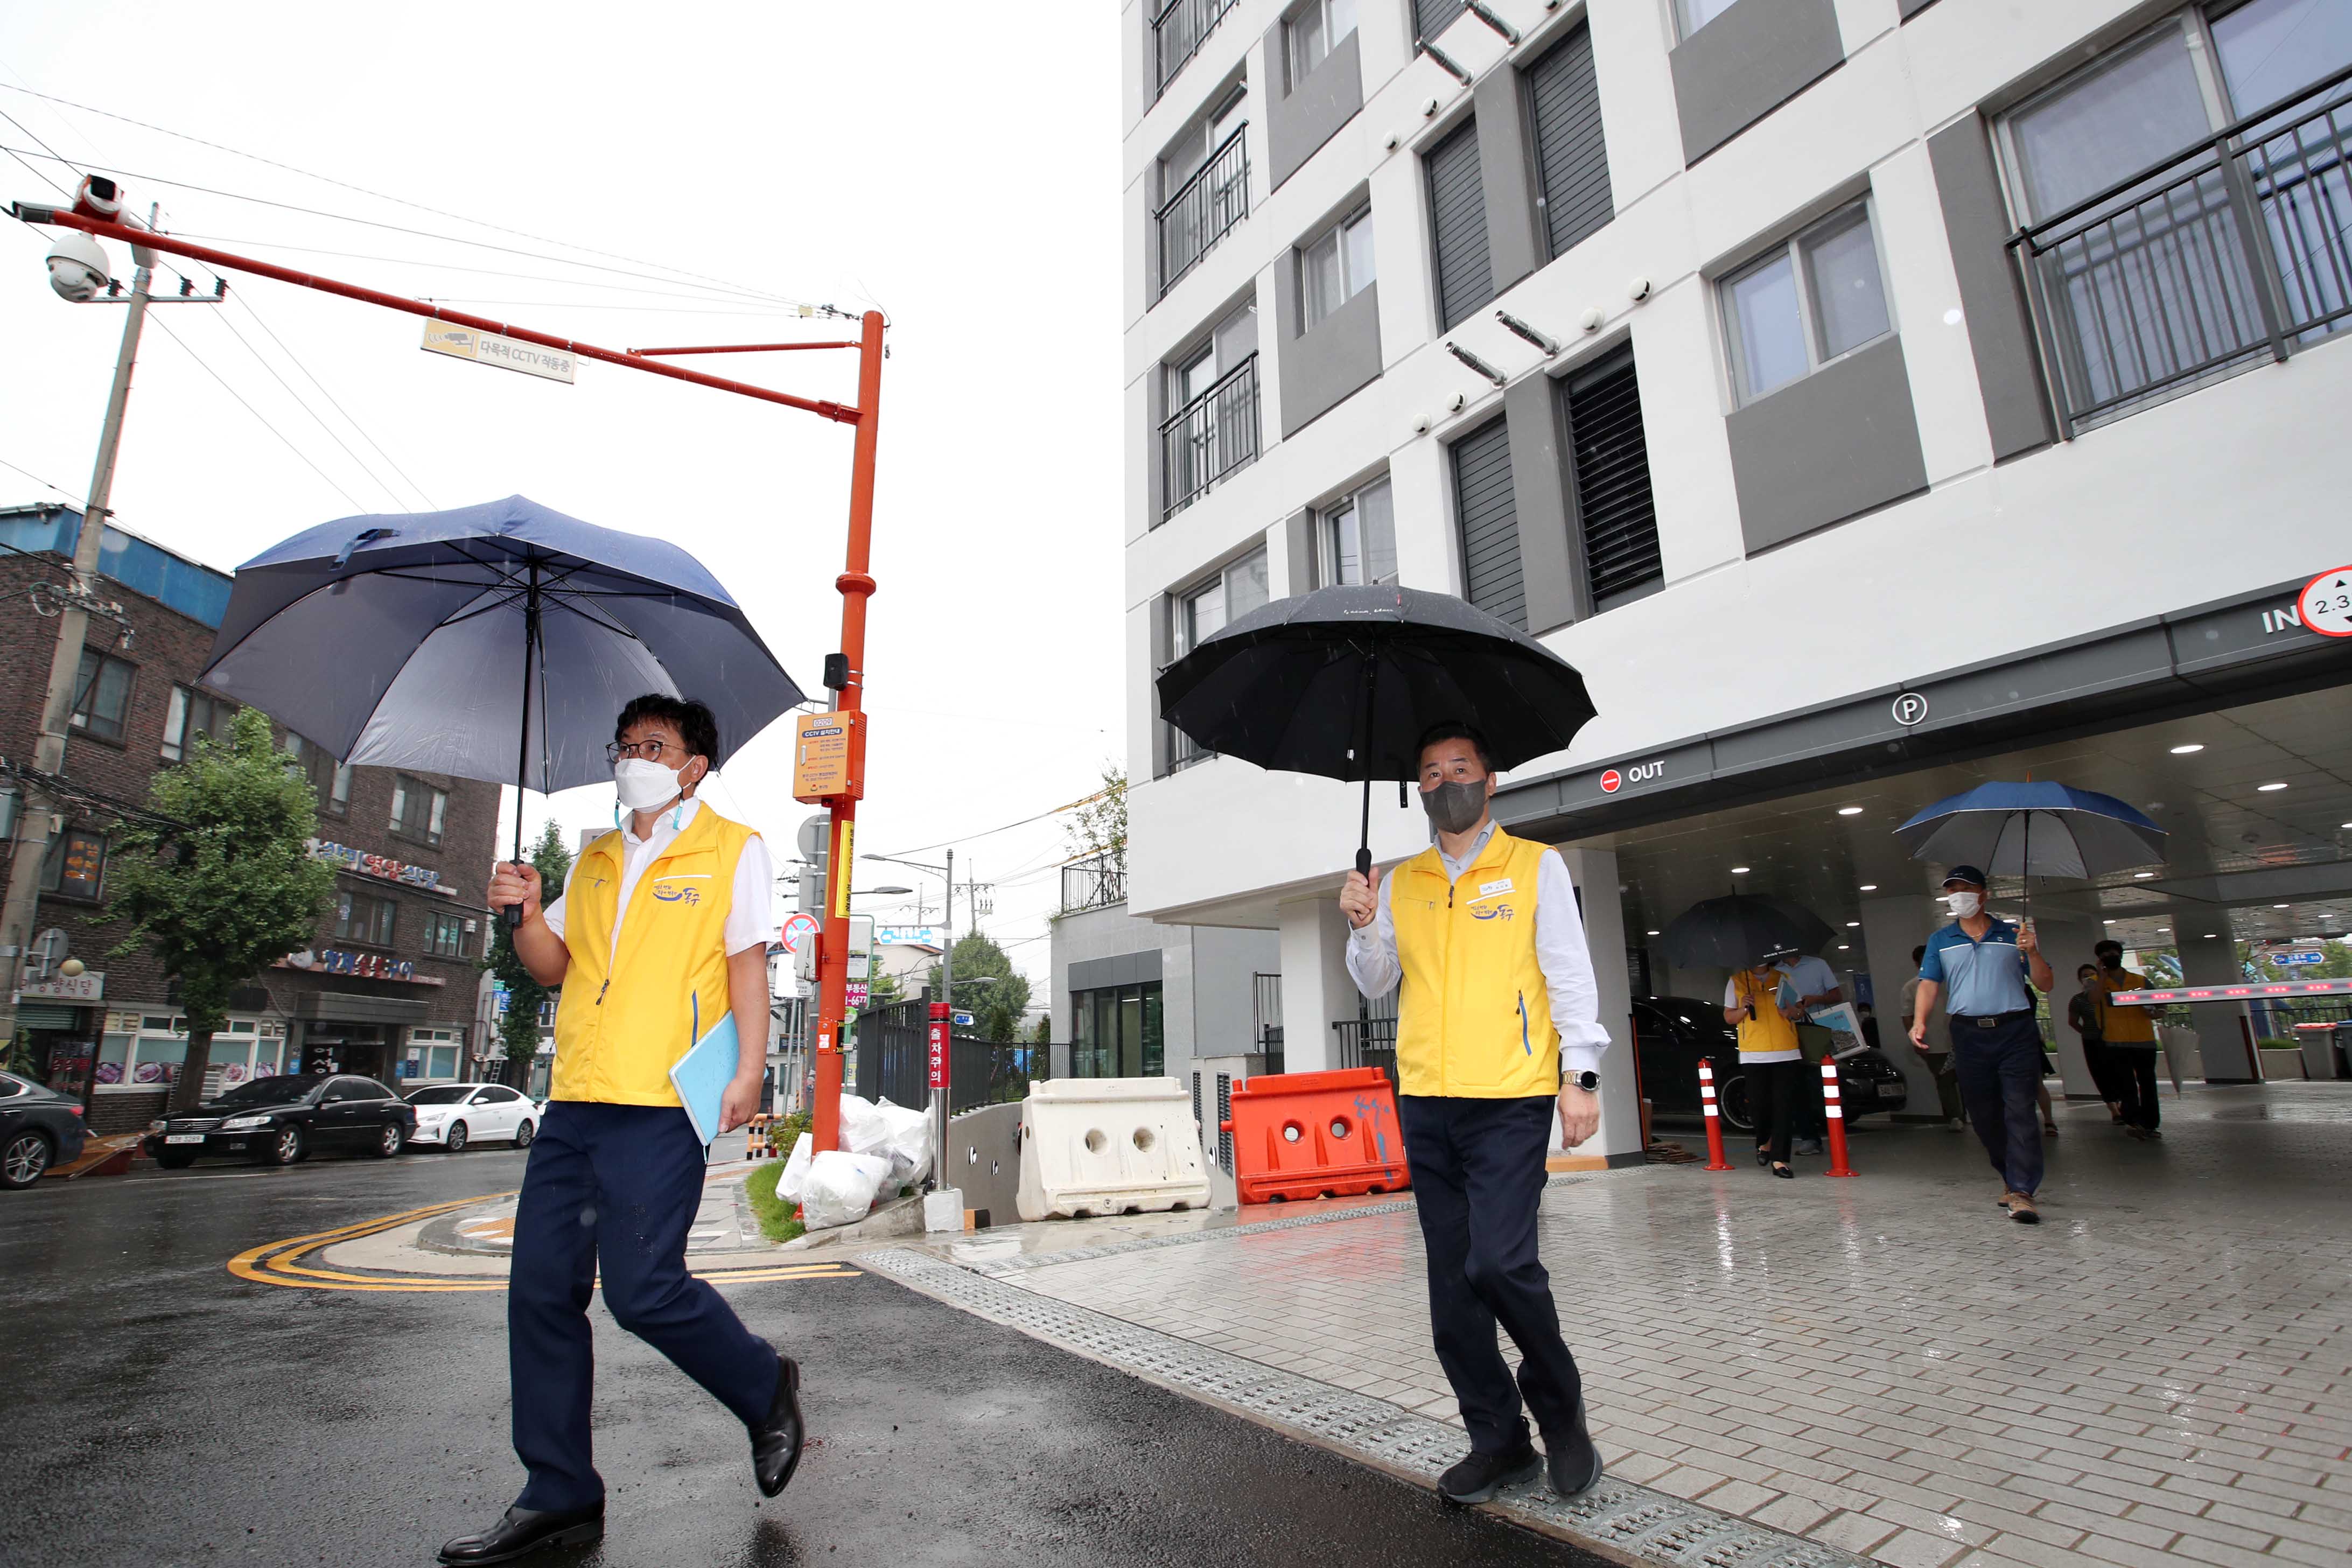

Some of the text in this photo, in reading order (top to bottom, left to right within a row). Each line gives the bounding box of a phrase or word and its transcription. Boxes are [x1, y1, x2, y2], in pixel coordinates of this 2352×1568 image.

[480, 341, 570, 373] 다목적 CCTV 작동중
[2262, 605, 2302, 633] IN
[1902, 699, 1917, 719] P
[1629, 760, 1664, 782] OUT
[683, 887, 700, 907] 동구
[1497, 904, 1514, 921] 동구
[845, 983, 867, 993] 부동산
[930, 1027, 942, 1083] 출차주의
